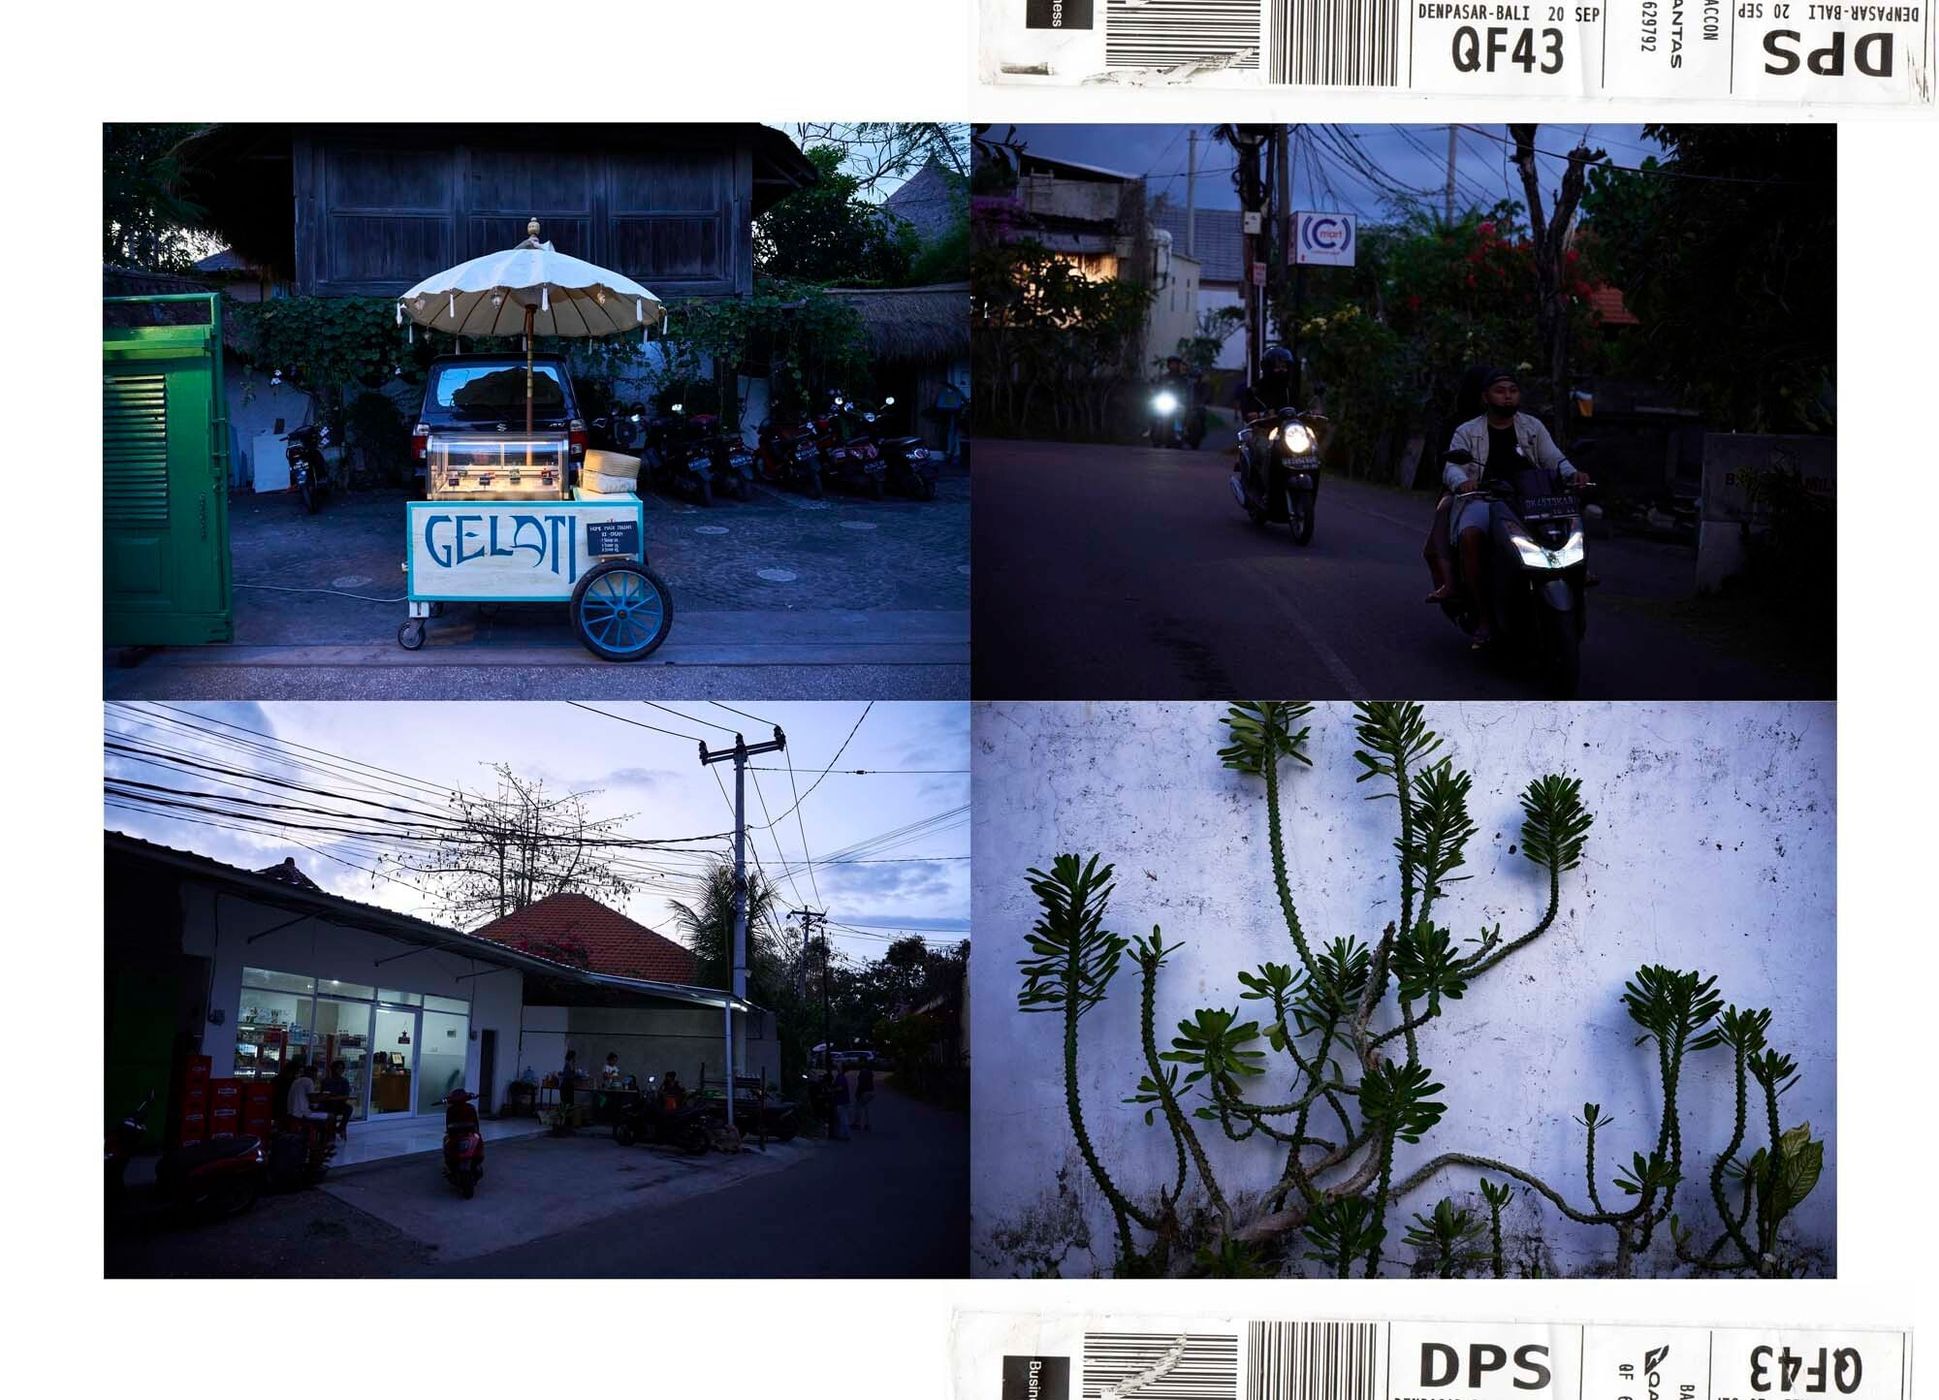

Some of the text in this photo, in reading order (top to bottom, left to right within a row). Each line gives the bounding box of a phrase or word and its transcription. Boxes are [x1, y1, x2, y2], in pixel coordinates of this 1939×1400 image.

[1418, 4, 1600, 22] DENPASAR-BALI 20 SEP
[1641, 1, 1658, 52] 629792
[1738, 3, 1919, 22] DENPASAR-BALI 20 SEP
[1452, 25, 1564, 75] QF43
[1762, 29, 1894, 77] DPS
[424, 514, 577, 585] GELATI
[1420, 1342, 1551, 1390] DPS
[1618, 1363, 1634, 1380] QF
[1750, 1345, 1863, 1395] QF43
